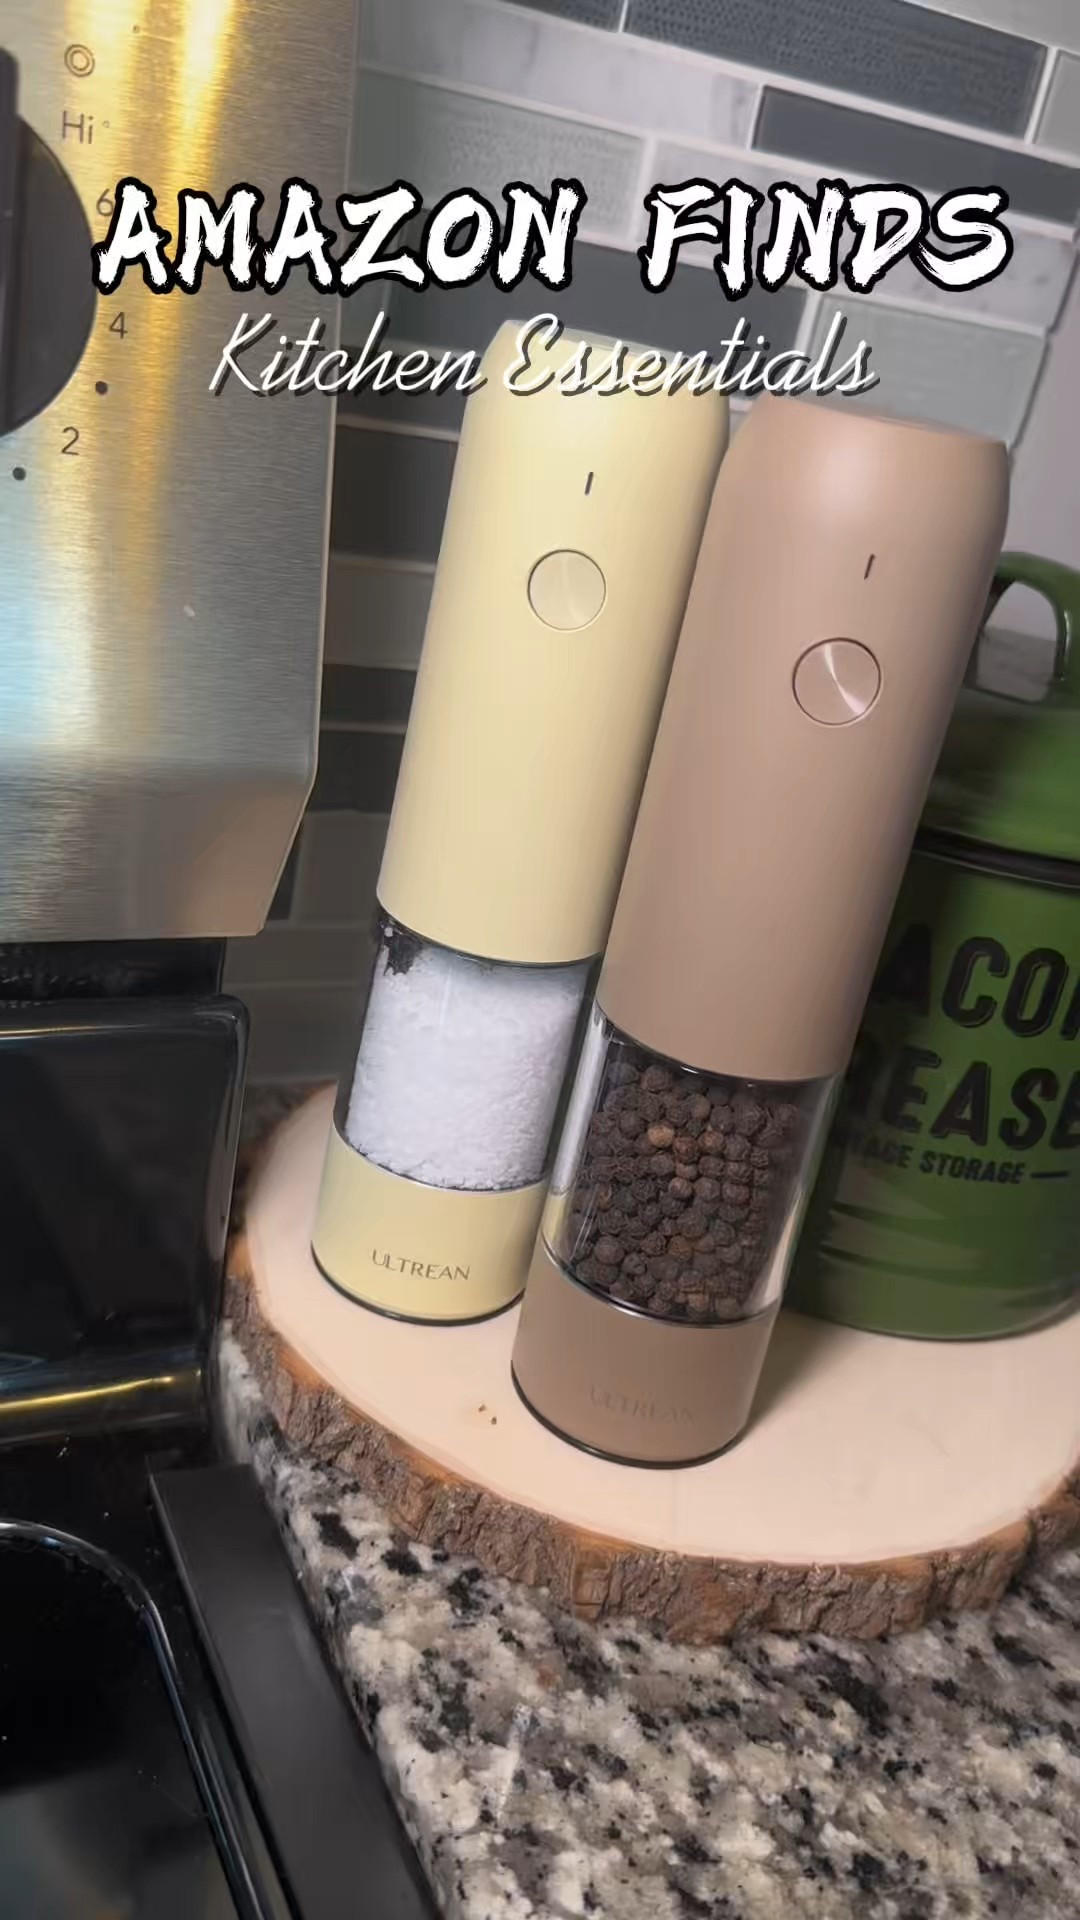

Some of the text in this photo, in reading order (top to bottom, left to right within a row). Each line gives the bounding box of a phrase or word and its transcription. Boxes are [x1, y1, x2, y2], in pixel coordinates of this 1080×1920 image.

[62, 110, 94, 145] Hi
[96, 188, 114, 217] 6
[108, 312, 127, 339] 4
[61, 426, 80, 456] 2
[919, 1150, 1025, 1185] STORAGE
[372, 1248, 470, 1281] ULTREAN
